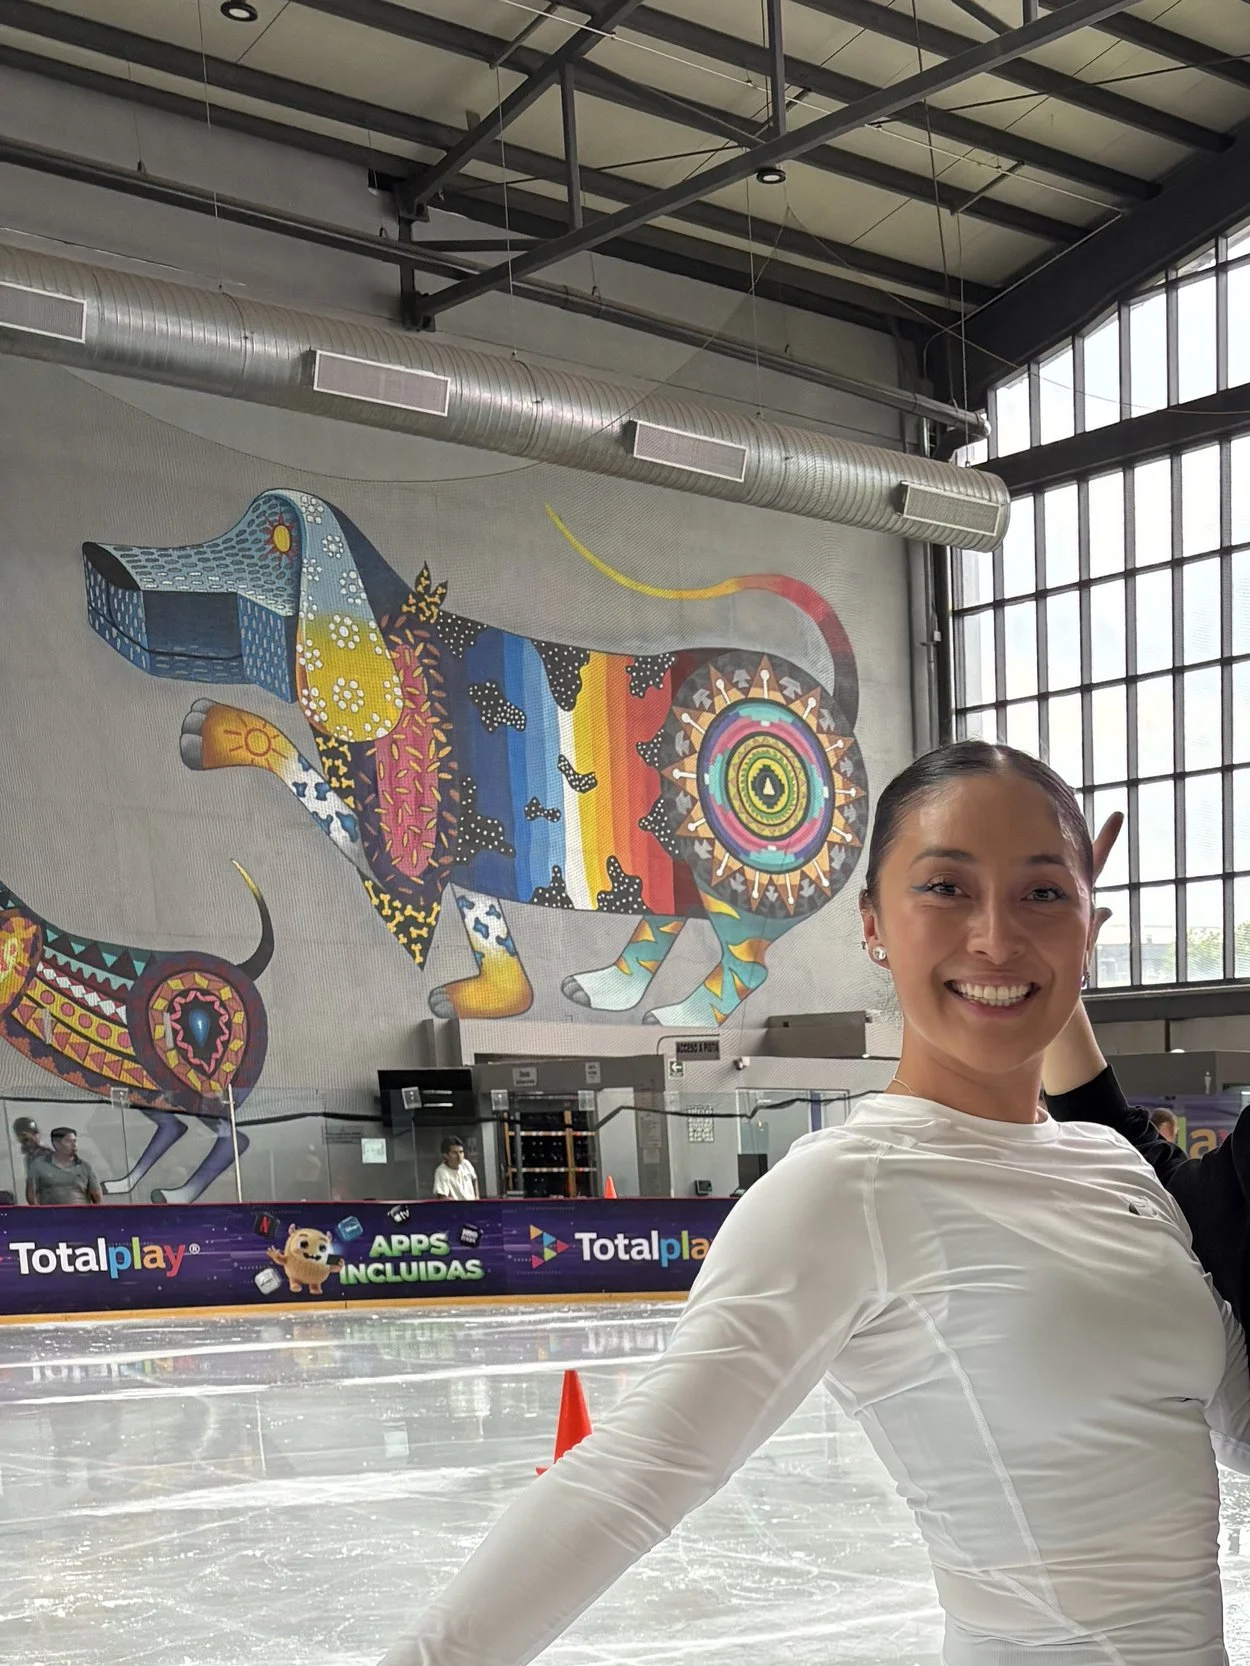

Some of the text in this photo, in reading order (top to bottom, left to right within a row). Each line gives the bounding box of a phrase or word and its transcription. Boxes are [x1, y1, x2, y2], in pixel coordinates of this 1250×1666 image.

[369, 1232, 450, 1258] APPS
[574, 1230, 710, 1267] Totalpla
[339, 1259, 485, 1285] INCLUIDAS
